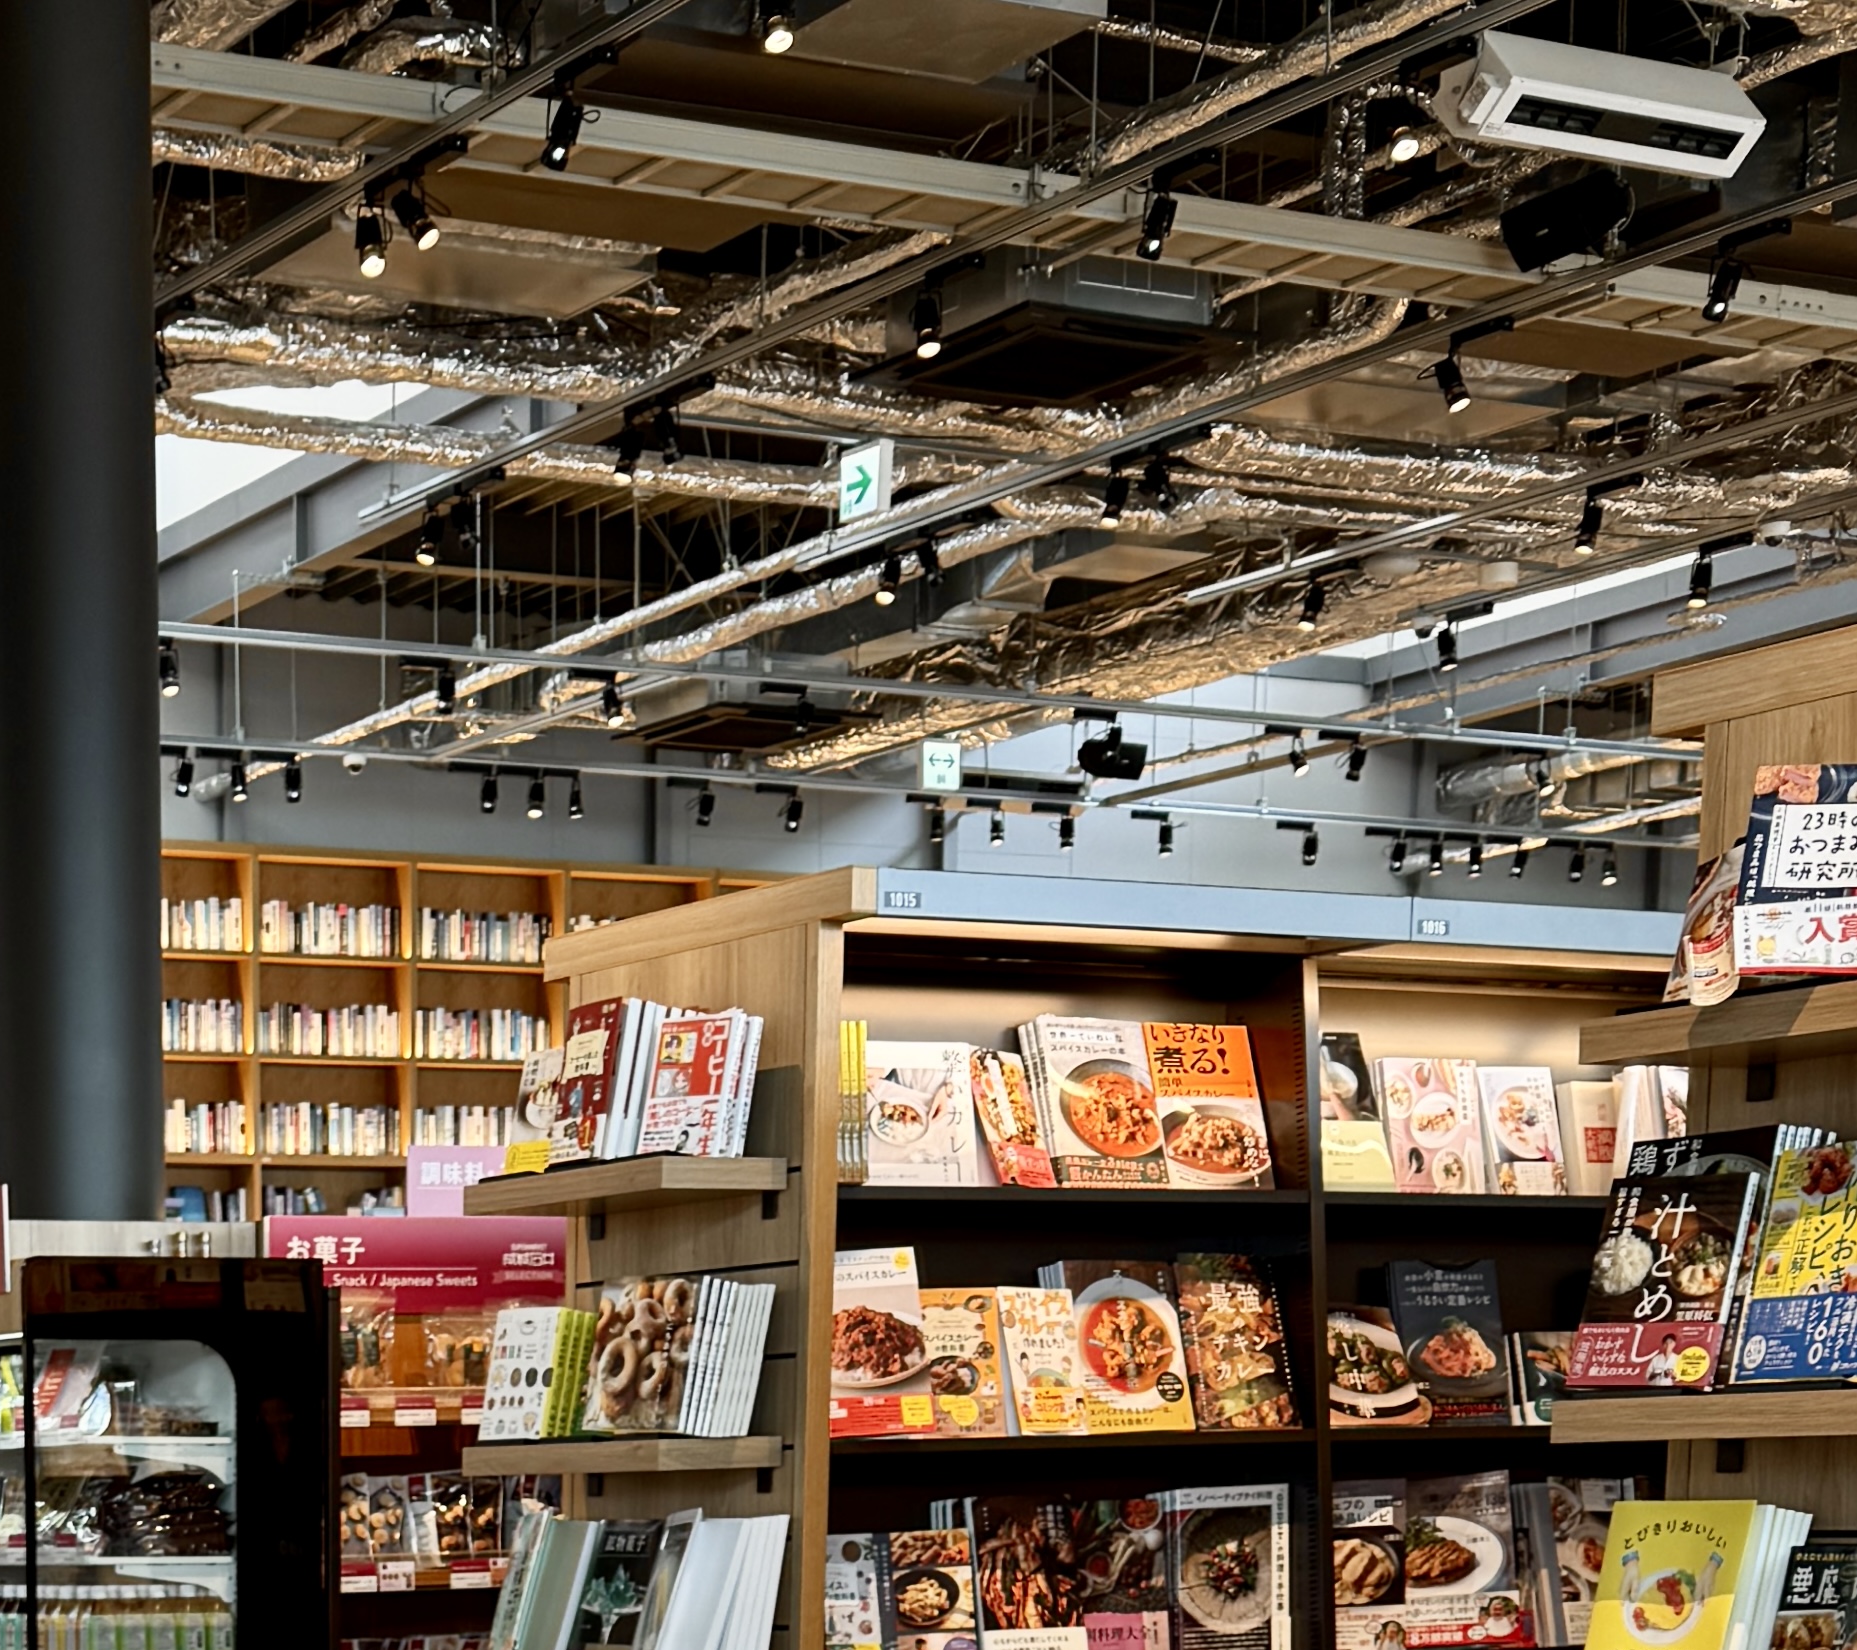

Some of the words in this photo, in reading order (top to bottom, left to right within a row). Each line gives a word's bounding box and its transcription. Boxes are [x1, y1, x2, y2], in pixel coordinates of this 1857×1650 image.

[890, 892, 917, 908] 1015
[1422, 919, 1446, 935] 1016
[1150, 1023, 1225, 1045] いきなり
[1153, 1046, 1230, 1075] 煮る!
[1158, 1077, 1183, 1088] 簡単
[286, 1235, 366, 1266] お菓子
[332, 1273, 367, 1287] Snack
[379, 1273, 434, 1289] Japanese
[435, 1273, 478, 1287] Sweets
[1002, 1291, 1072, 1317] スパイス
[1206, 1283, 1263, 1314] 最強
[1211, 1332, 1269, 1354] チキン
[1216, 1361, 1275, 1382] カレー
[1623, 1518, 1728, 1549] とびきりおいしい
